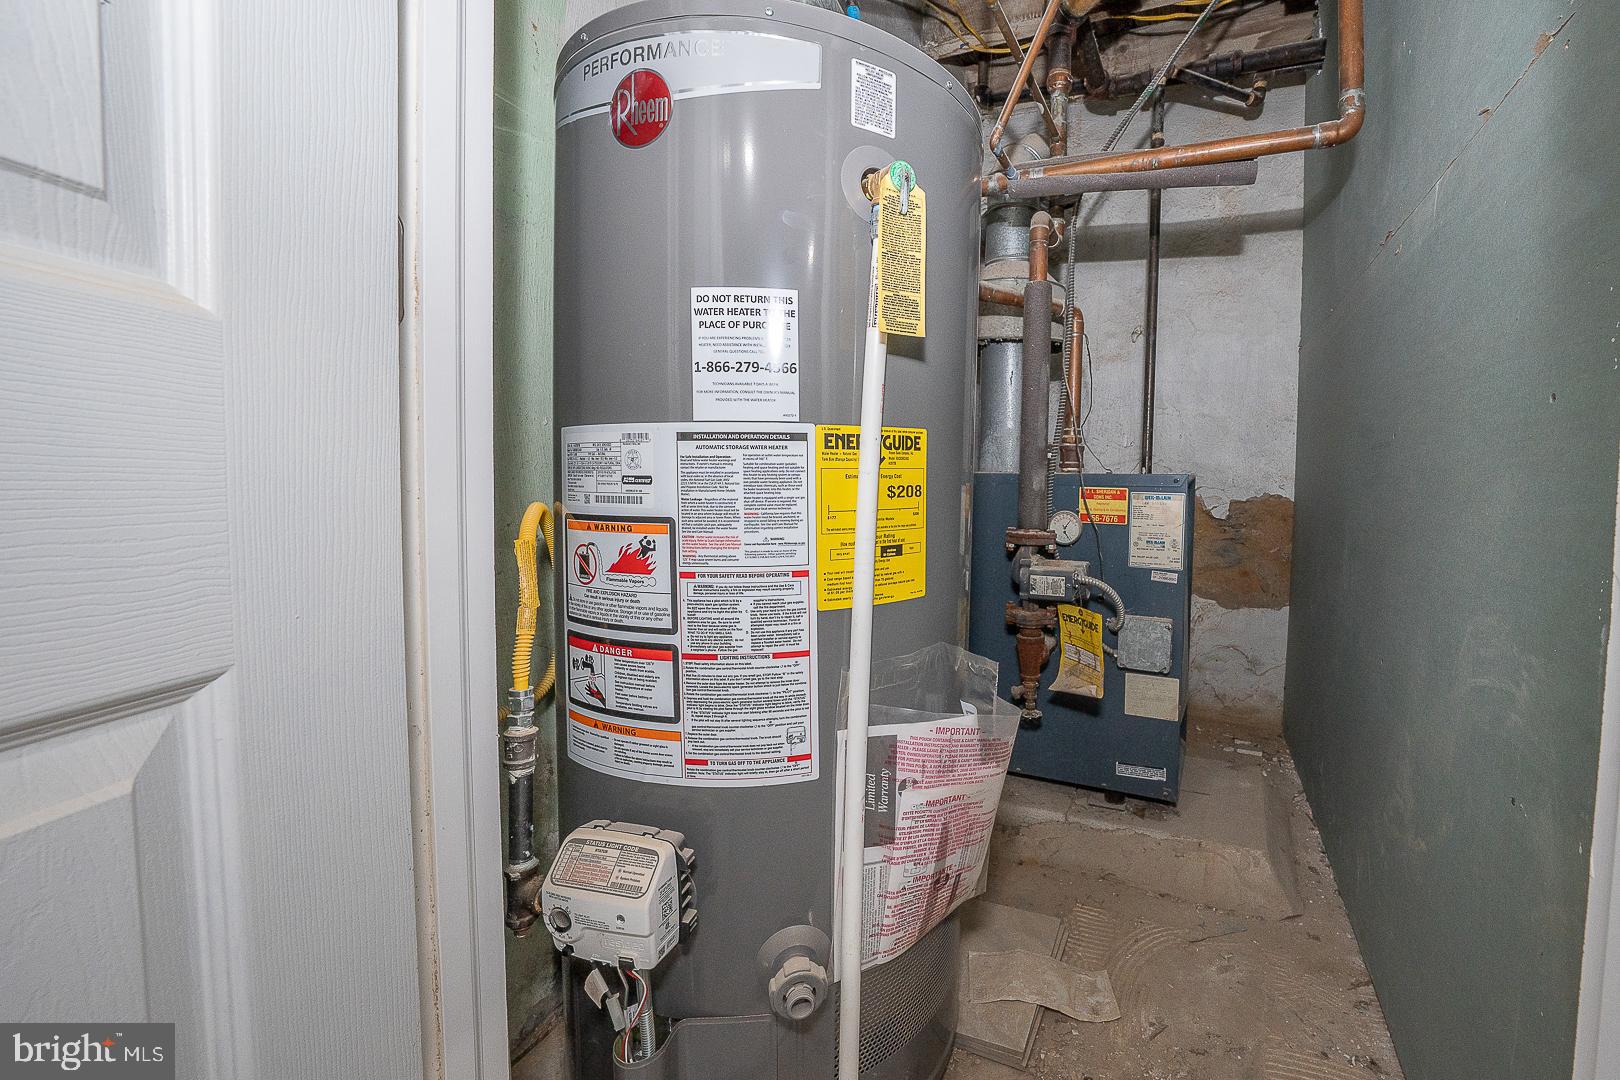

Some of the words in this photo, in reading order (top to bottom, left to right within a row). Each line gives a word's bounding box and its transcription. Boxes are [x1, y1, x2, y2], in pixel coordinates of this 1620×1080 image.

[583, 40, 722, 82] PERFORMANCE
[616, 72, 669, 137] Rheem
[696, 294, 709, 303] DO
[712, 294, 731, 303] NOT
[733, 295, 770, 304] RETURN
[773, 296, 793, 305] THIS
[694, 308, 724, 316] WATER
[727, 308, 761, 316] HEATER
[699, 320, 725, 328] PLACE
[743, 321, 791, 331] PURCE
[887, 484, 922, 500] $208
[594, 524, 632, 532] WARNING
[599, 646, 633, 657] DANGER
[602, 724, 637, 736] WARNING
[935, 726, 981, 736] IMPORTANT
[865, 773, 876, 811] Limited
[878, 768, 892, 813] Warranty
[925, 794, 967, 807] IMPORTANT
[585, 840, 606, 848] STATUS
[606, 842, 622, 850] LIGHT
[623, 844, 640, 852] CODE
